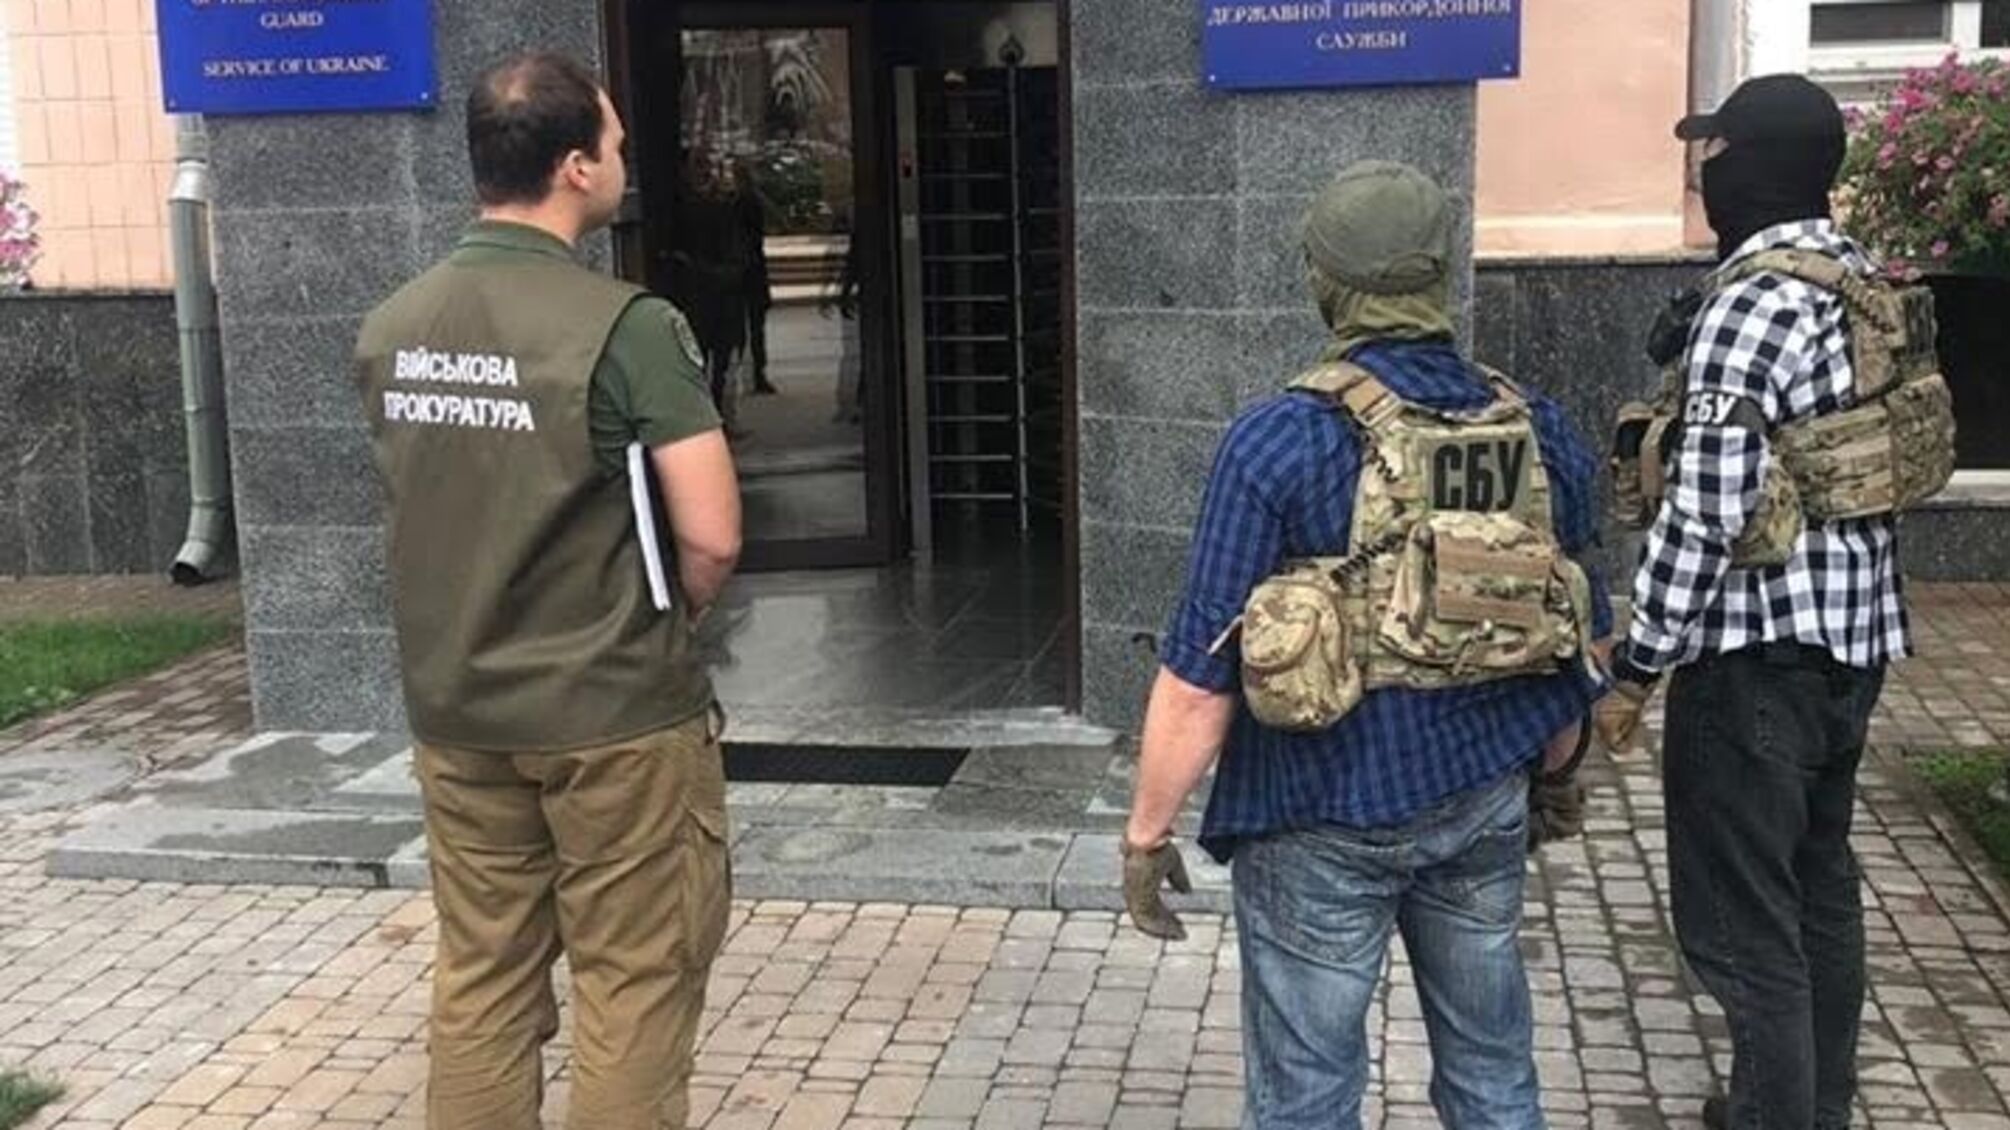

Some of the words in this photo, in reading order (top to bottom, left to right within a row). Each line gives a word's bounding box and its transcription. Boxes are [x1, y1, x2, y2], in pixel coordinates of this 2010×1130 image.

[260, 11, 324, 28] GUARD
[1207, 0, 1331, 25] ДЕРЖАВНОЇ
[1316, 30, 1407, 49] СЛУЖБИ
[203, 60, 275, 77] SERVICE
[280, 59, 300, 74] OF
[306, 56, 389, 74] UKRAINE
[394, 346, 518, 388] ВІЙСЬКОВА
[383, 390, 535, 431] ПРОКУРАТУРА
[1684, 393, 1736, 425] СБУ
[1433, 440, 1526, 513] СБУ
